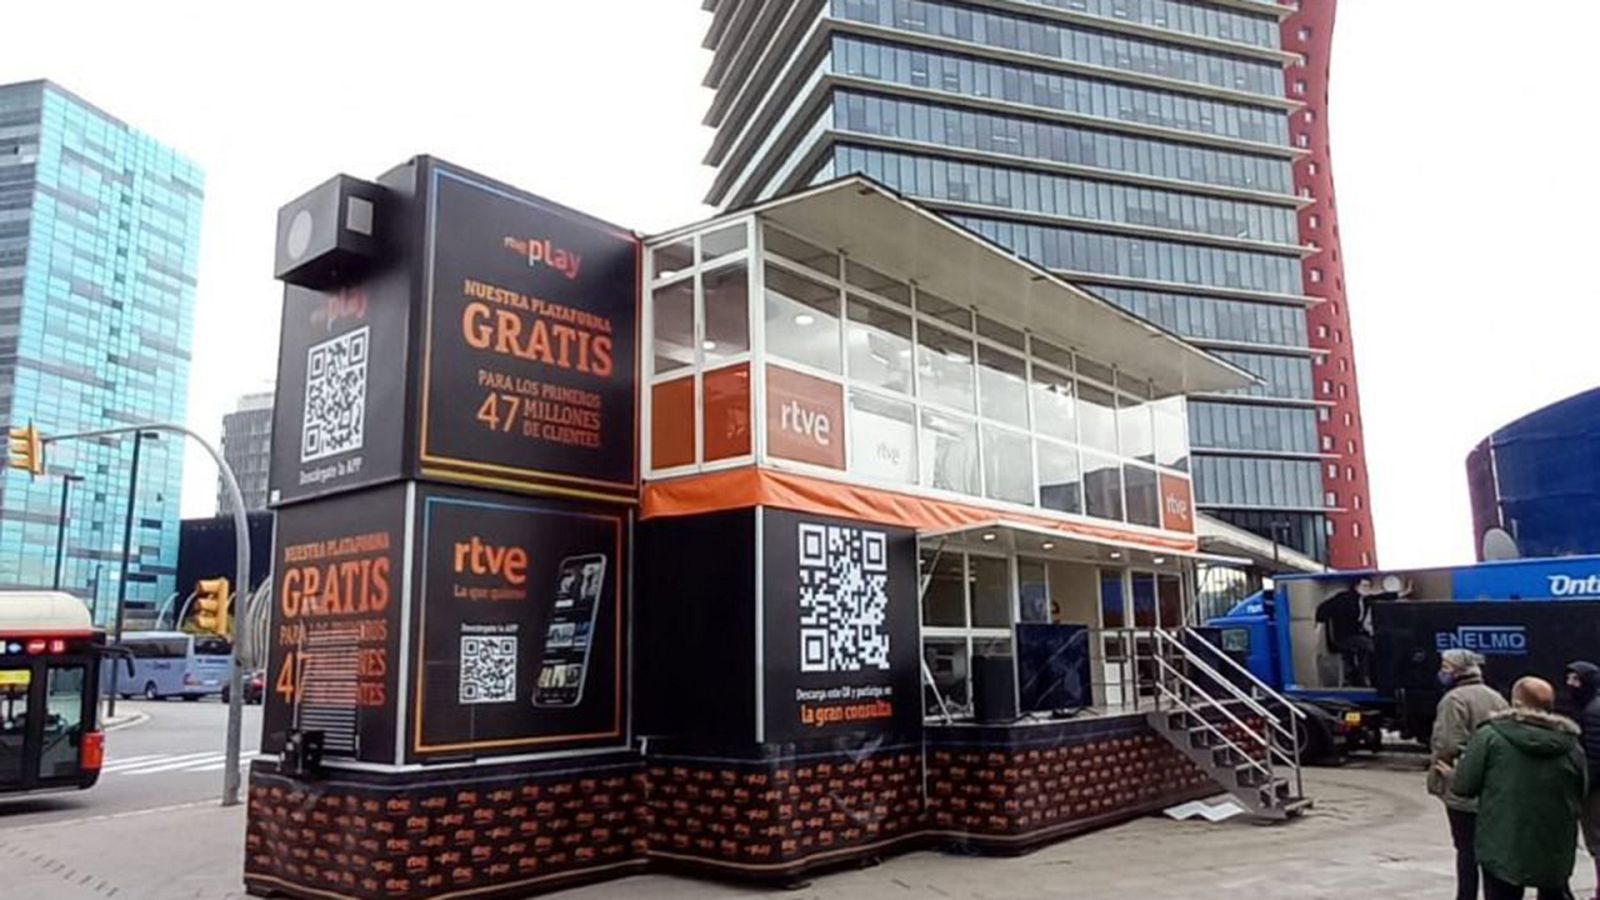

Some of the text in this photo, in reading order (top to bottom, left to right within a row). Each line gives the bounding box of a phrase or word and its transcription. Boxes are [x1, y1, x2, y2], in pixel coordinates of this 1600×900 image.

[527, 238, 582, 279] play
[463, 279, 530, 310] NUESTRA
[462, 301, 613, 377] GRATIS
[477, 369, 514, 391] PARA
[515, 378, 540, 396] LOS
[476, 392, 520, 432] 47
[523, 399, 601, 431] MILLONES
[523, 421, 541, 437] DE
[779, 400, 831, 446] rtve
[454, 536, 528, 584] rtve
[282, 557, 390, 618] GRATIS
[1435, 631, 1526, 649] ENELMO
[816, 707, 844, 727] gran
[845, 701, 892, 719] consulta
